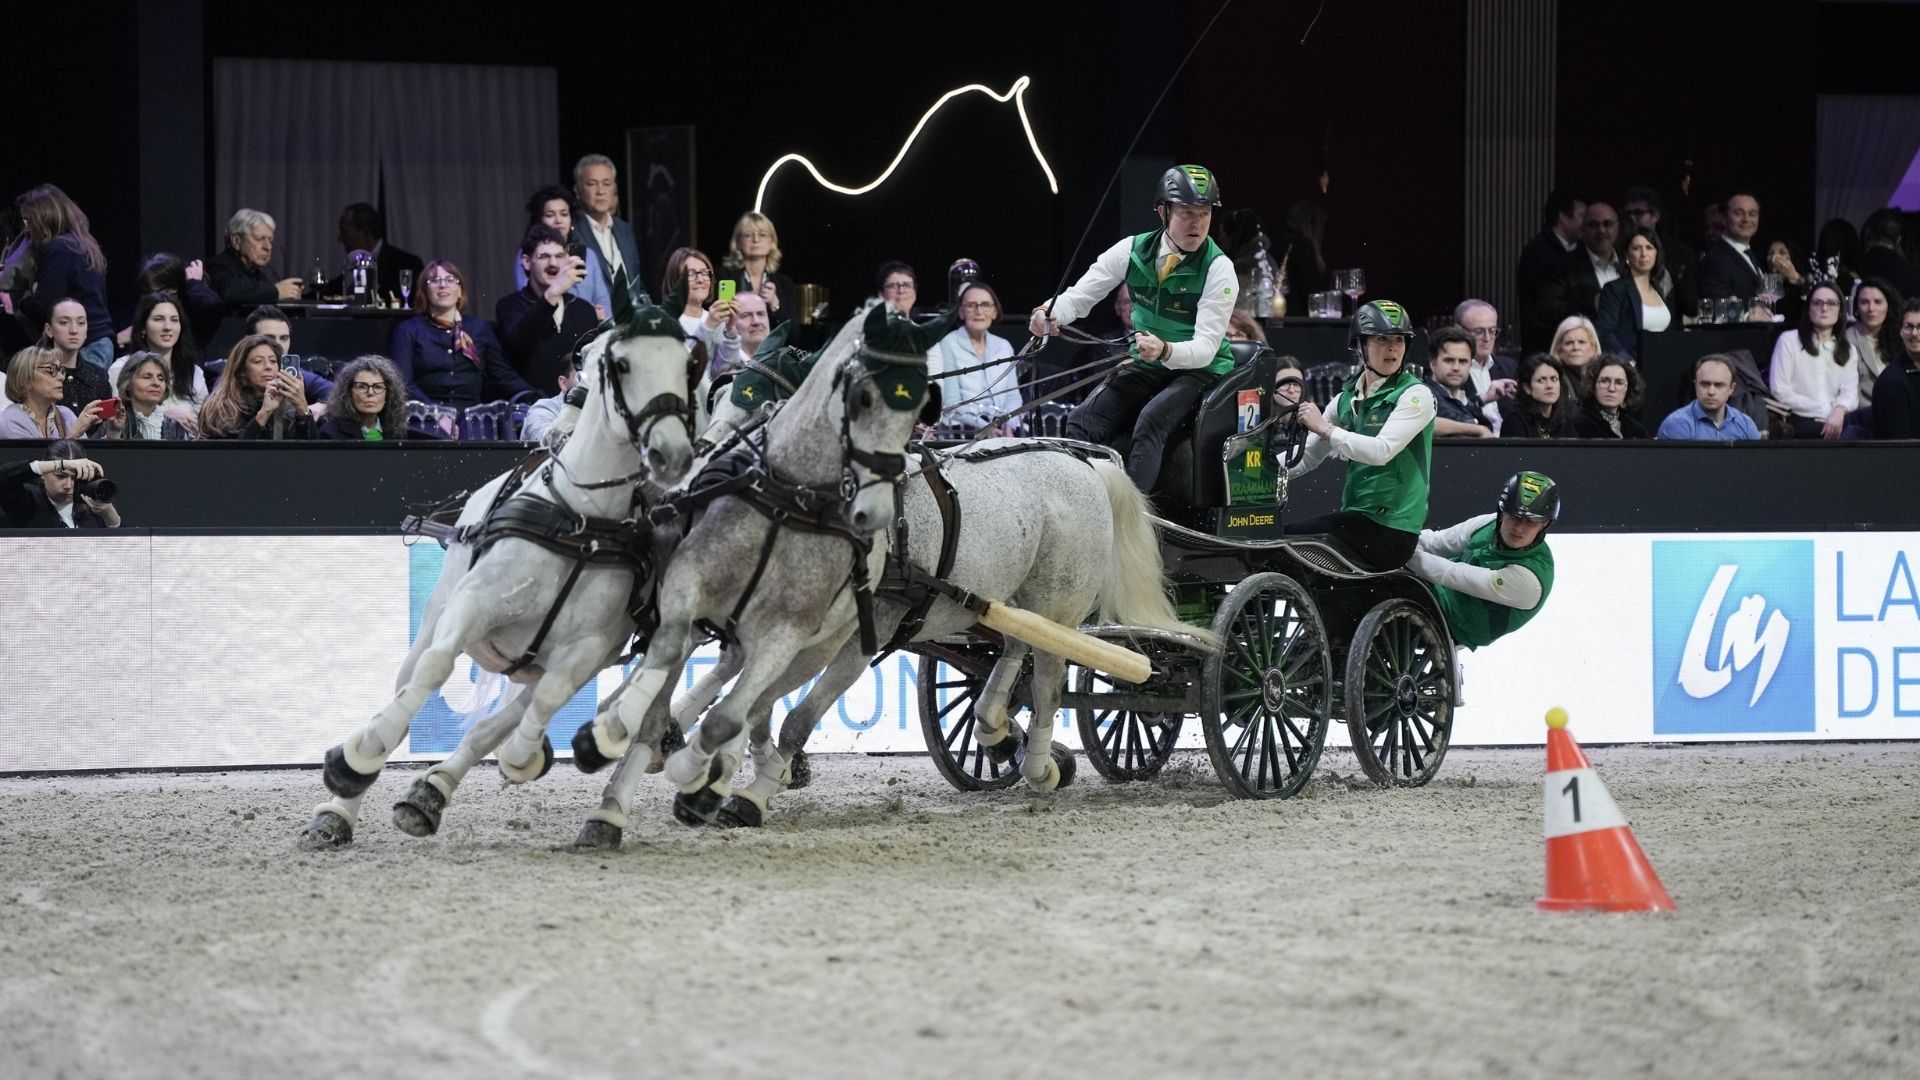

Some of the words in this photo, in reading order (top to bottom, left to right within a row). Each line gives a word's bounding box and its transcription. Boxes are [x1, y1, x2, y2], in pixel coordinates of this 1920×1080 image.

[1247, 404, 1254, 429] 2
[1246, 451, 1262, 468] KR
[1227, 515, 1249, 528] JOHN
[1249, 514, 1274, 526] DEERE
[1562, 775, 1582, 823] 1
